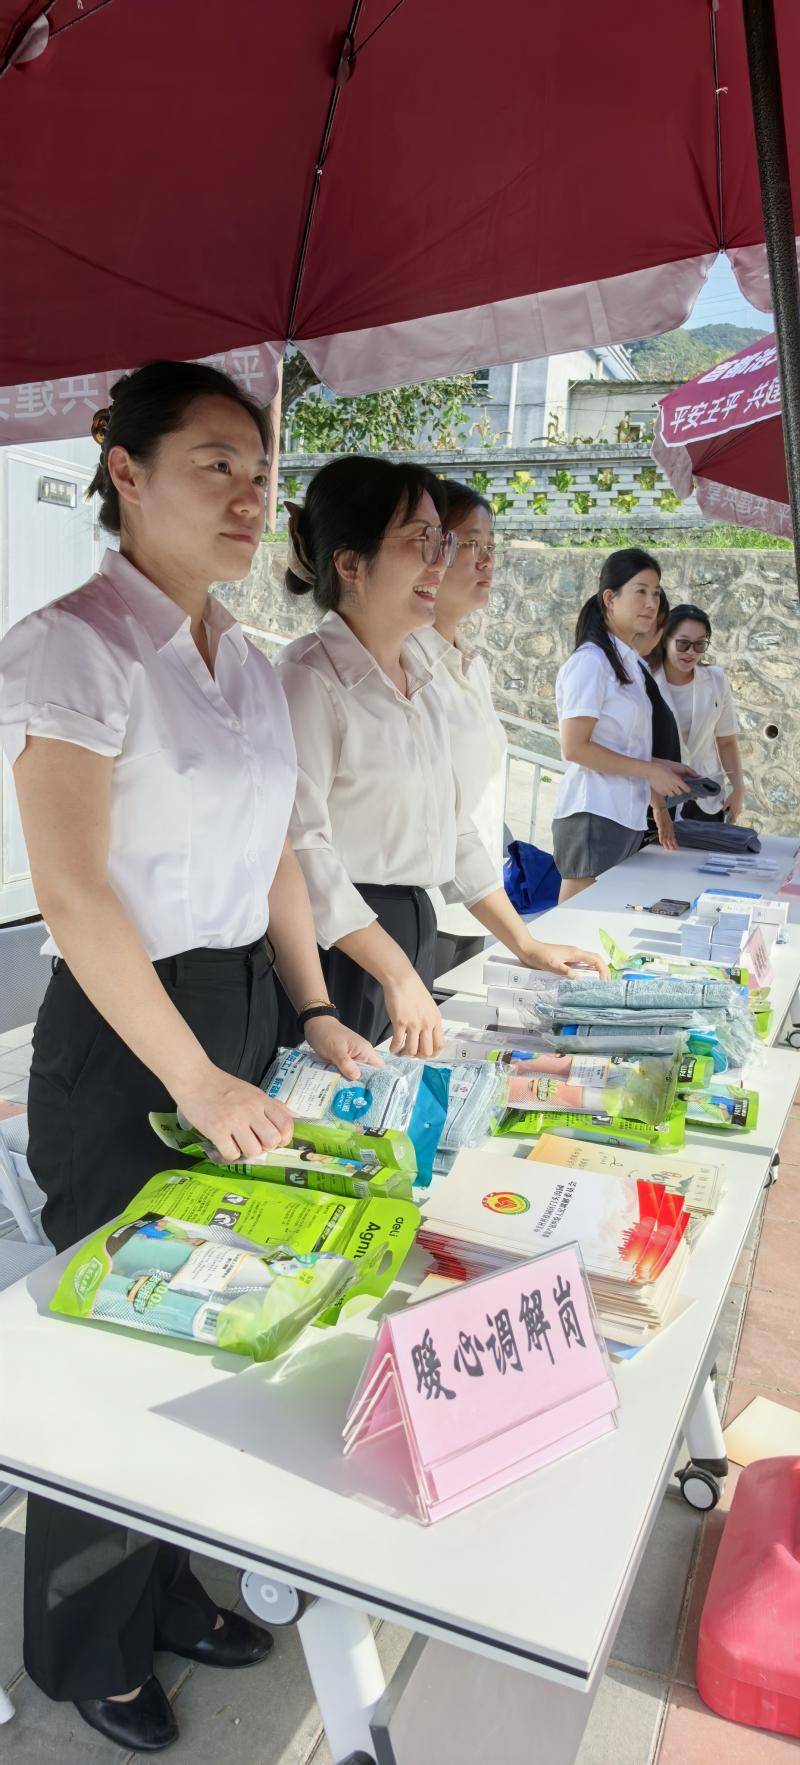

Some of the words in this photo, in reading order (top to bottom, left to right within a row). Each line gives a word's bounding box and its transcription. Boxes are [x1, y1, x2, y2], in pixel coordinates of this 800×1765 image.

[670, 389, 744, 434] 平安王平
[387, 1216, 405, 1238] deli
[411, 1274, 586, 1401] 暖心调解岗
